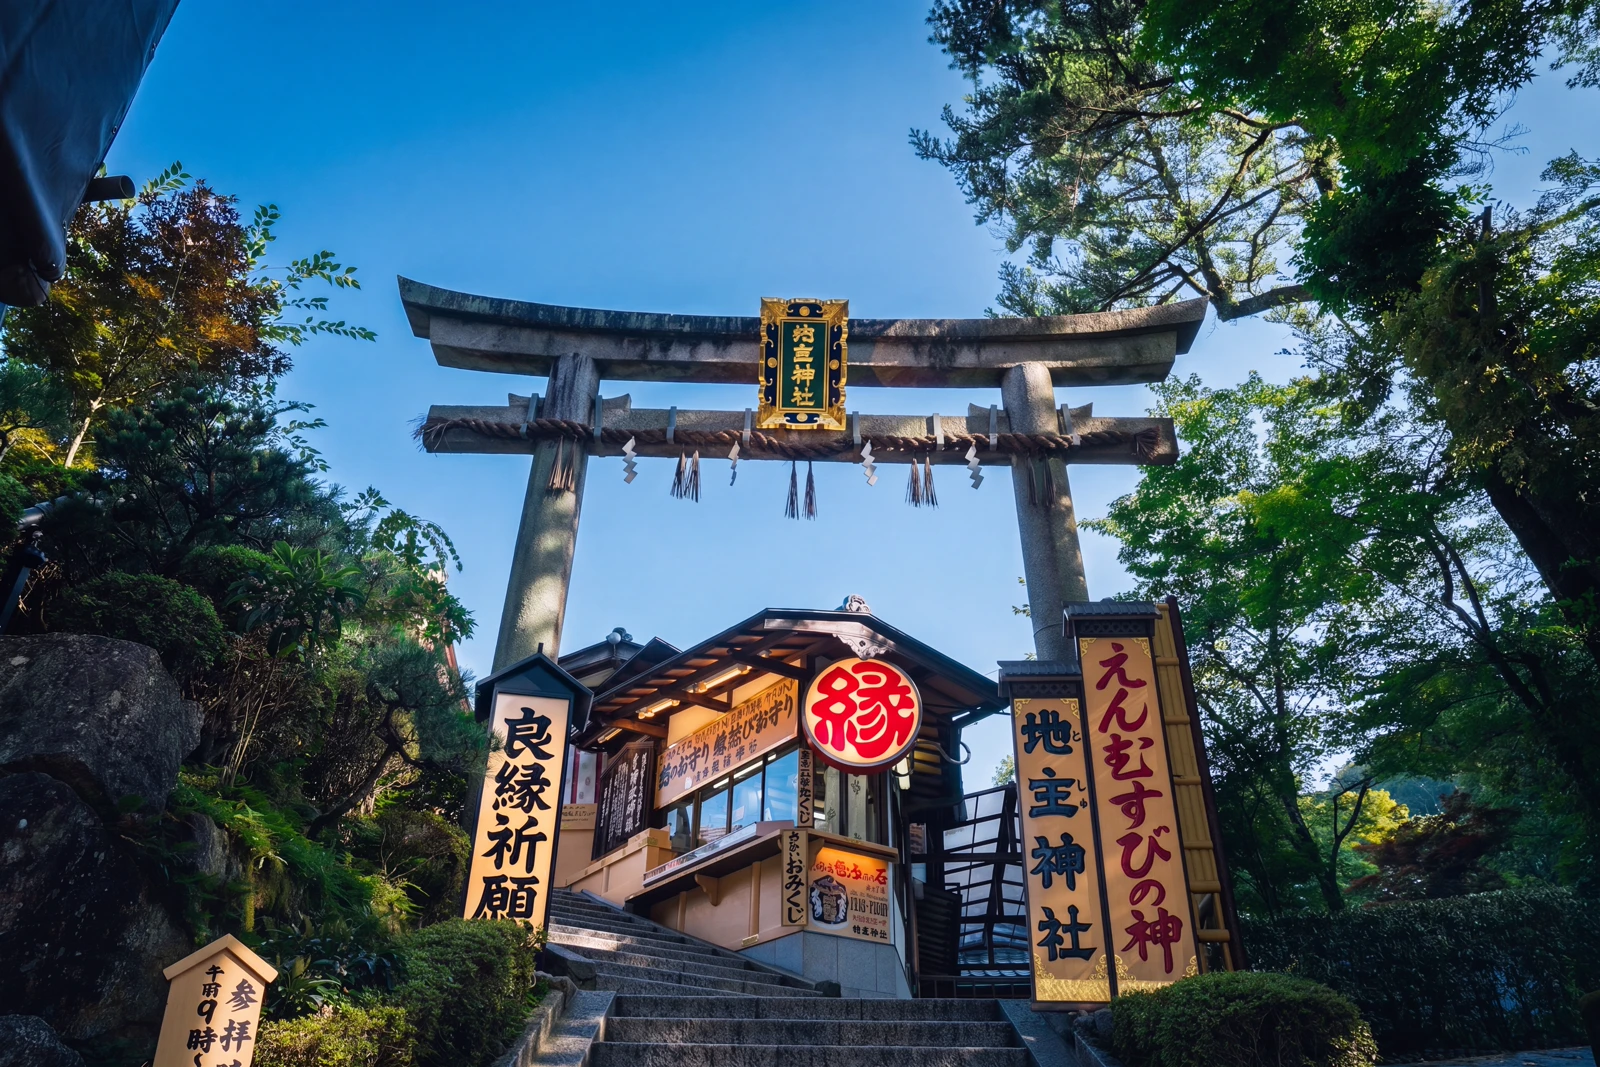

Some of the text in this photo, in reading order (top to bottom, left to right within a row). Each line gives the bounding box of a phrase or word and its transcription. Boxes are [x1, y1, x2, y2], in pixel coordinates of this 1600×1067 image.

[472, 707, 555, 931] 良縁祈願
[811, 662, 915, 759] 縁
[1095, 642, 1183, 974] えんむすびの神
[1021, 709, 1097, 962] 地主神社
